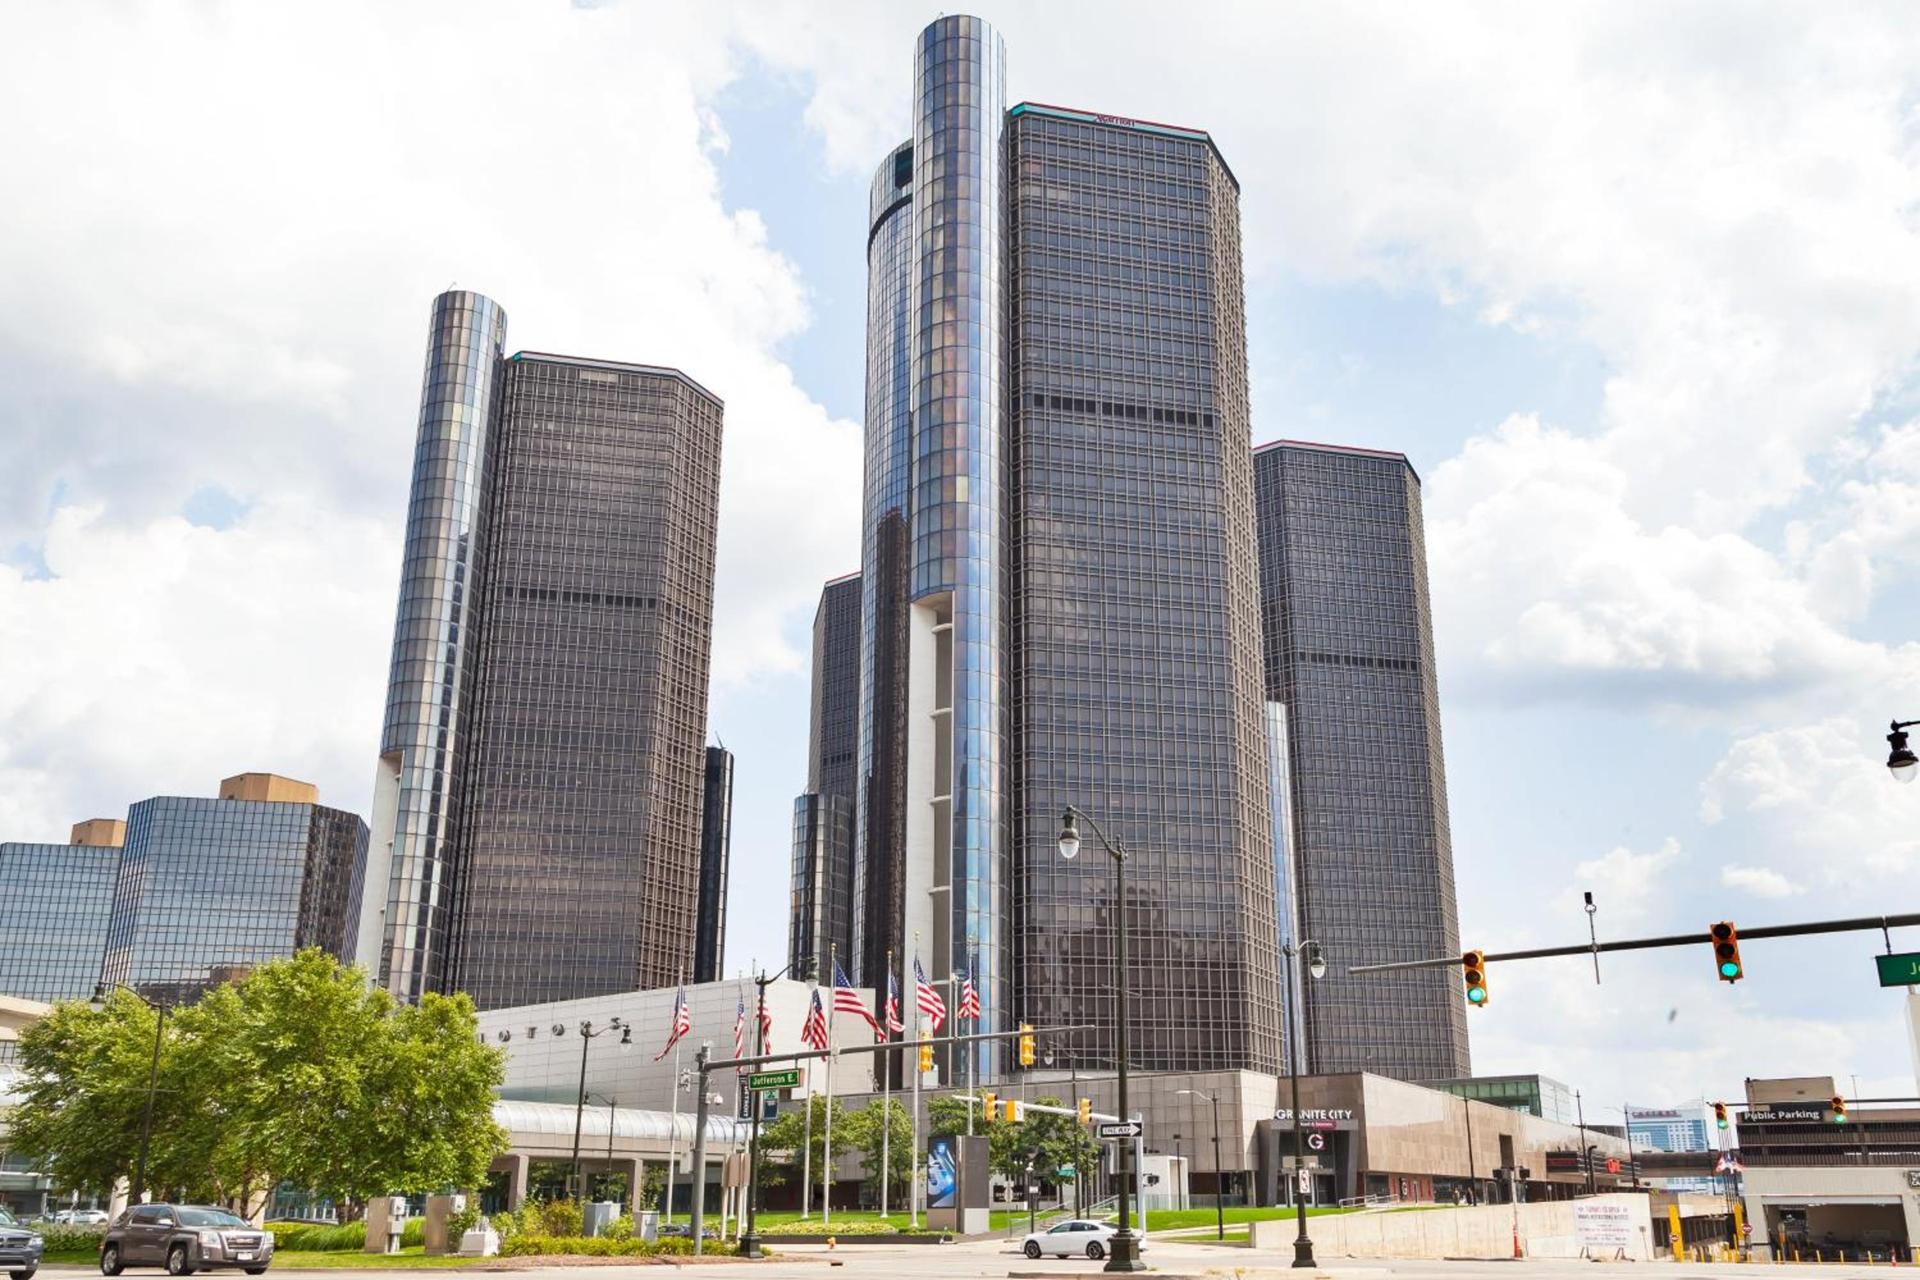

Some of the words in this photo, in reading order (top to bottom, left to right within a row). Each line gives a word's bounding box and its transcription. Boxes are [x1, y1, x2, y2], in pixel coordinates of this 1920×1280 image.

[753, 1075, 785, 1086] Jefferson
[1328, 1109, 1352, 1119] CITY
[1744, 1111, 1776, 1121] Public
[1778, 1110, 1820, 1120] Parking
[1307, 1133, 1324, 1150] G
